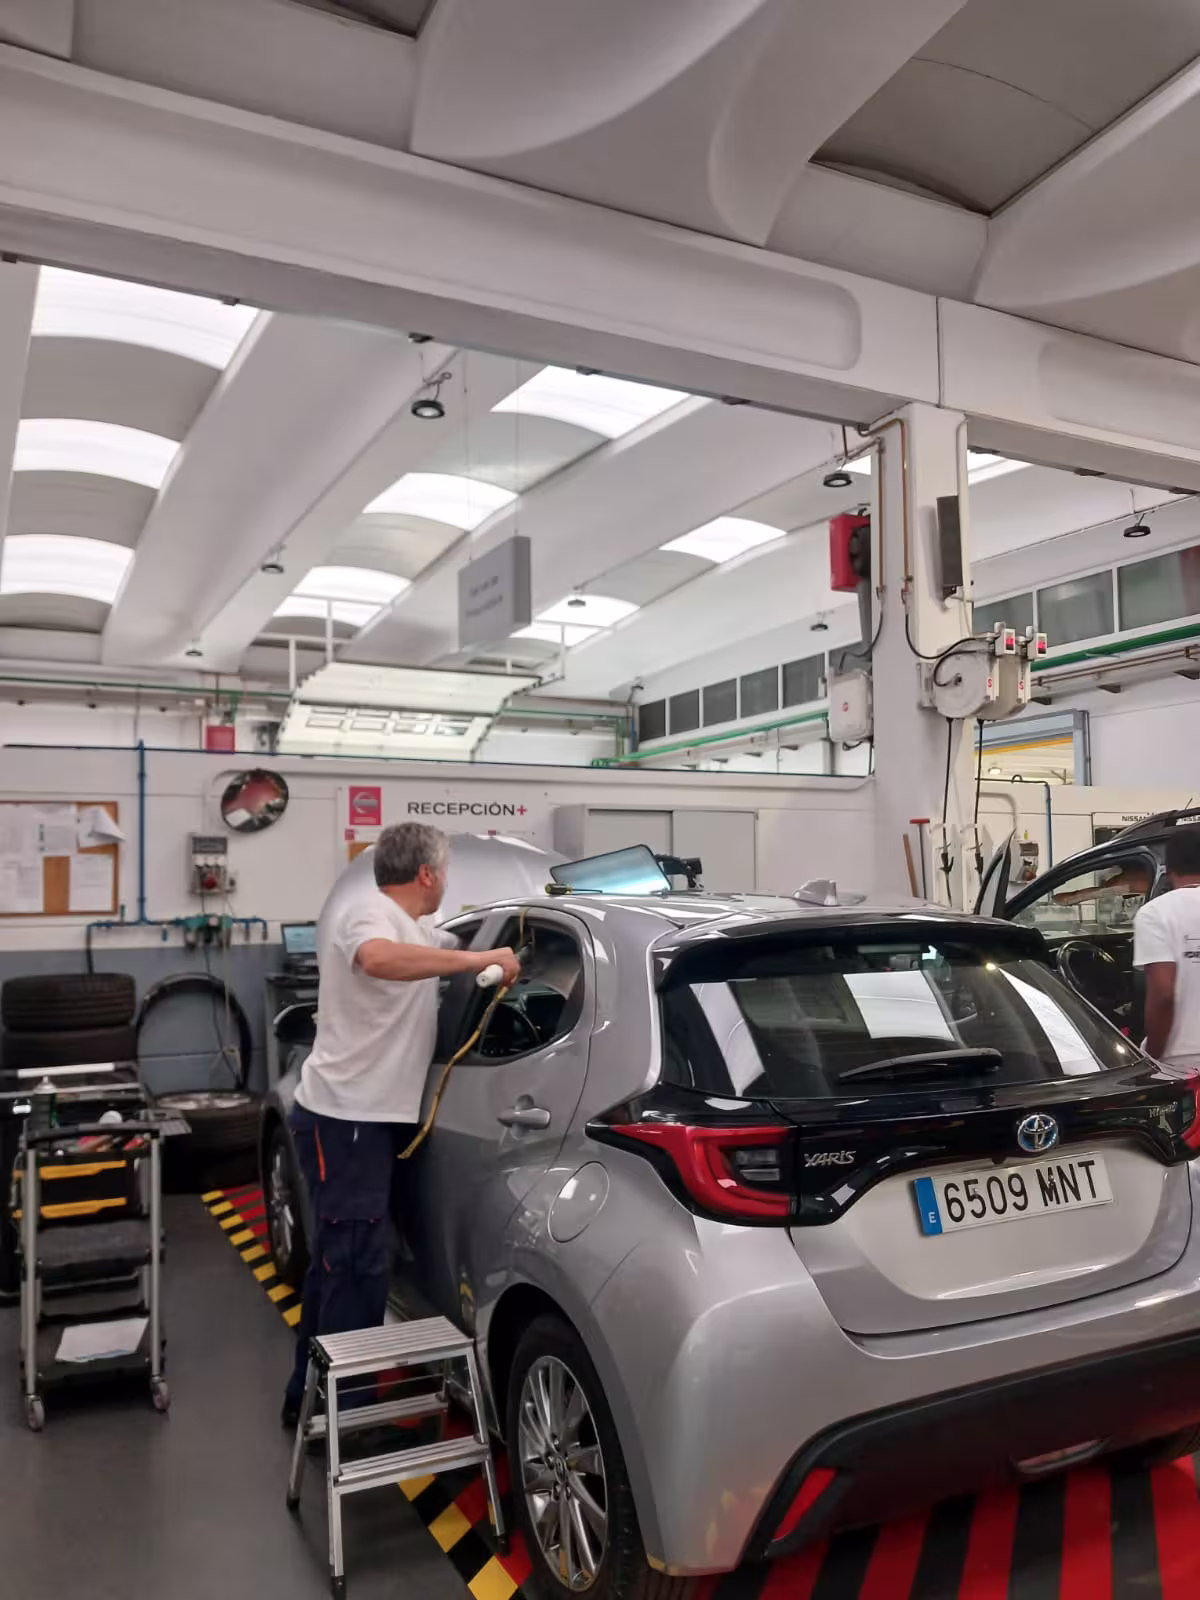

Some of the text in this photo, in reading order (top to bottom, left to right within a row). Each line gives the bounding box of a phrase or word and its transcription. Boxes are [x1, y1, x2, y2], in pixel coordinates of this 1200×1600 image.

[804, 1150, 857, 1168] YARIS
[943, 1159, 1097, 1223] 6509 MNT
[928, 1211, 937, 1224] E
